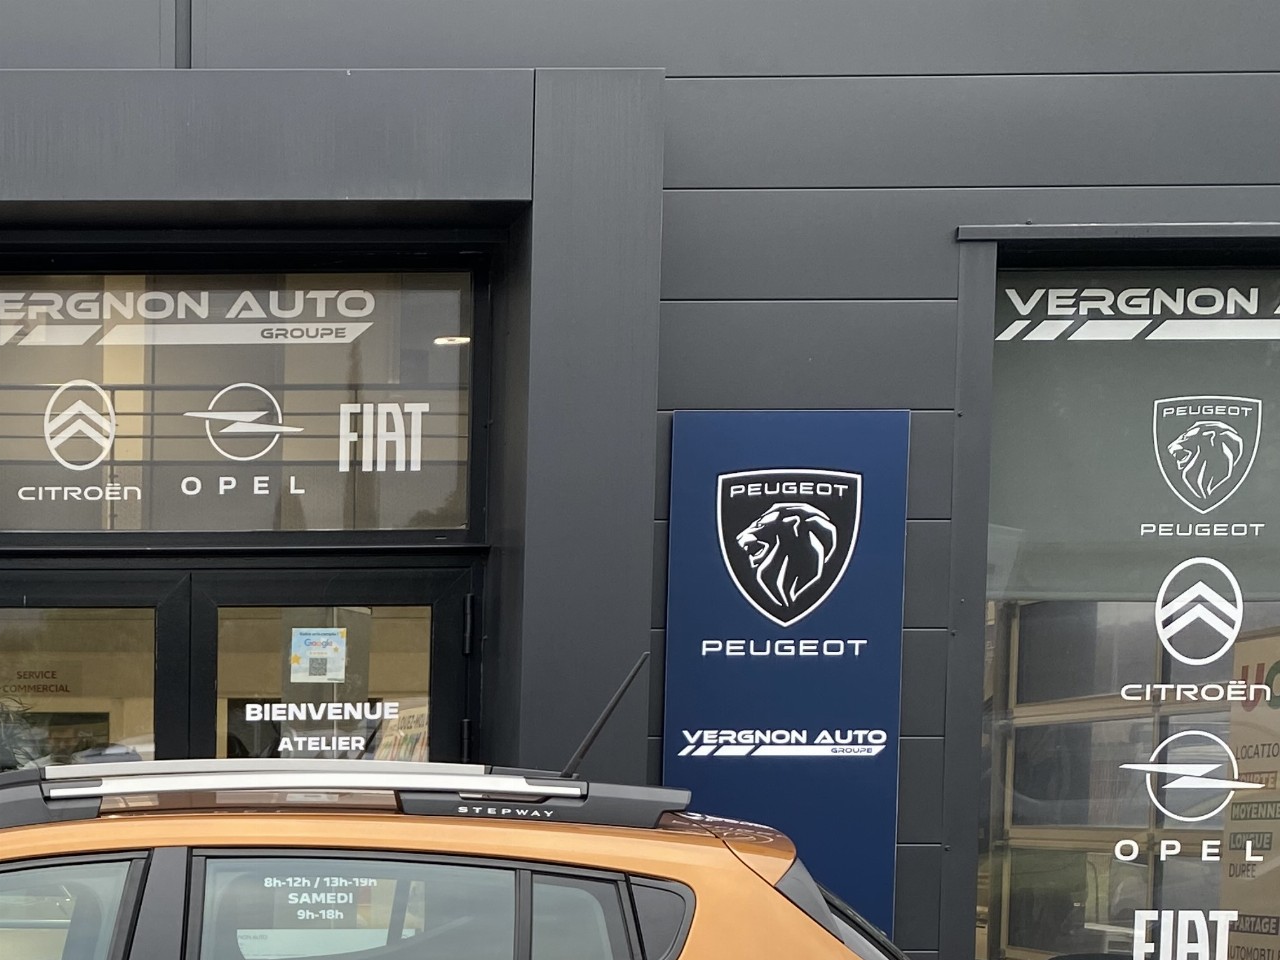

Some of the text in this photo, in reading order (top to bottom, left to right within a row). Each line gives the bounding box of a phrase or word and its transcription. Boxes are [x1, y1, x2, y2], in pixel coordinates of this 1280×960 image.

[225, 290, 376, 318] AUTO
[1005, 287, 1259, 316] VERGNON
[260, 327, 347, 339] GROUPE
[1162, 405, 1253, 418] PEUGEOT
[338, 402, 430, 473] FIAT
[180, 475, 306, 496] OPEL
[729, 481, 849, 498] PEUGEOT
[1140, 523, 1266, 536] PEUGEOT
[701, 639, 868, 657] PEUGEOT
[16, 670, 58, 680] SERVICE
[2, 684, 71, 694] COMMERCIAL
[245, 701, 400, 721] BIENVENUE
[277, 736, 366, 751] ATELIER
[682, 729, 888, 745] VERGNON AUTO
[457, 806, 555, 818] STEPWAY
[1114, 839, 1264, 862] OPEL
[263, 877, 378, 889] 8h-12h / 13h-19h
[288, 892, 354, 904] SAMEDI
[296, 909, 344, 920] 9h-18h
